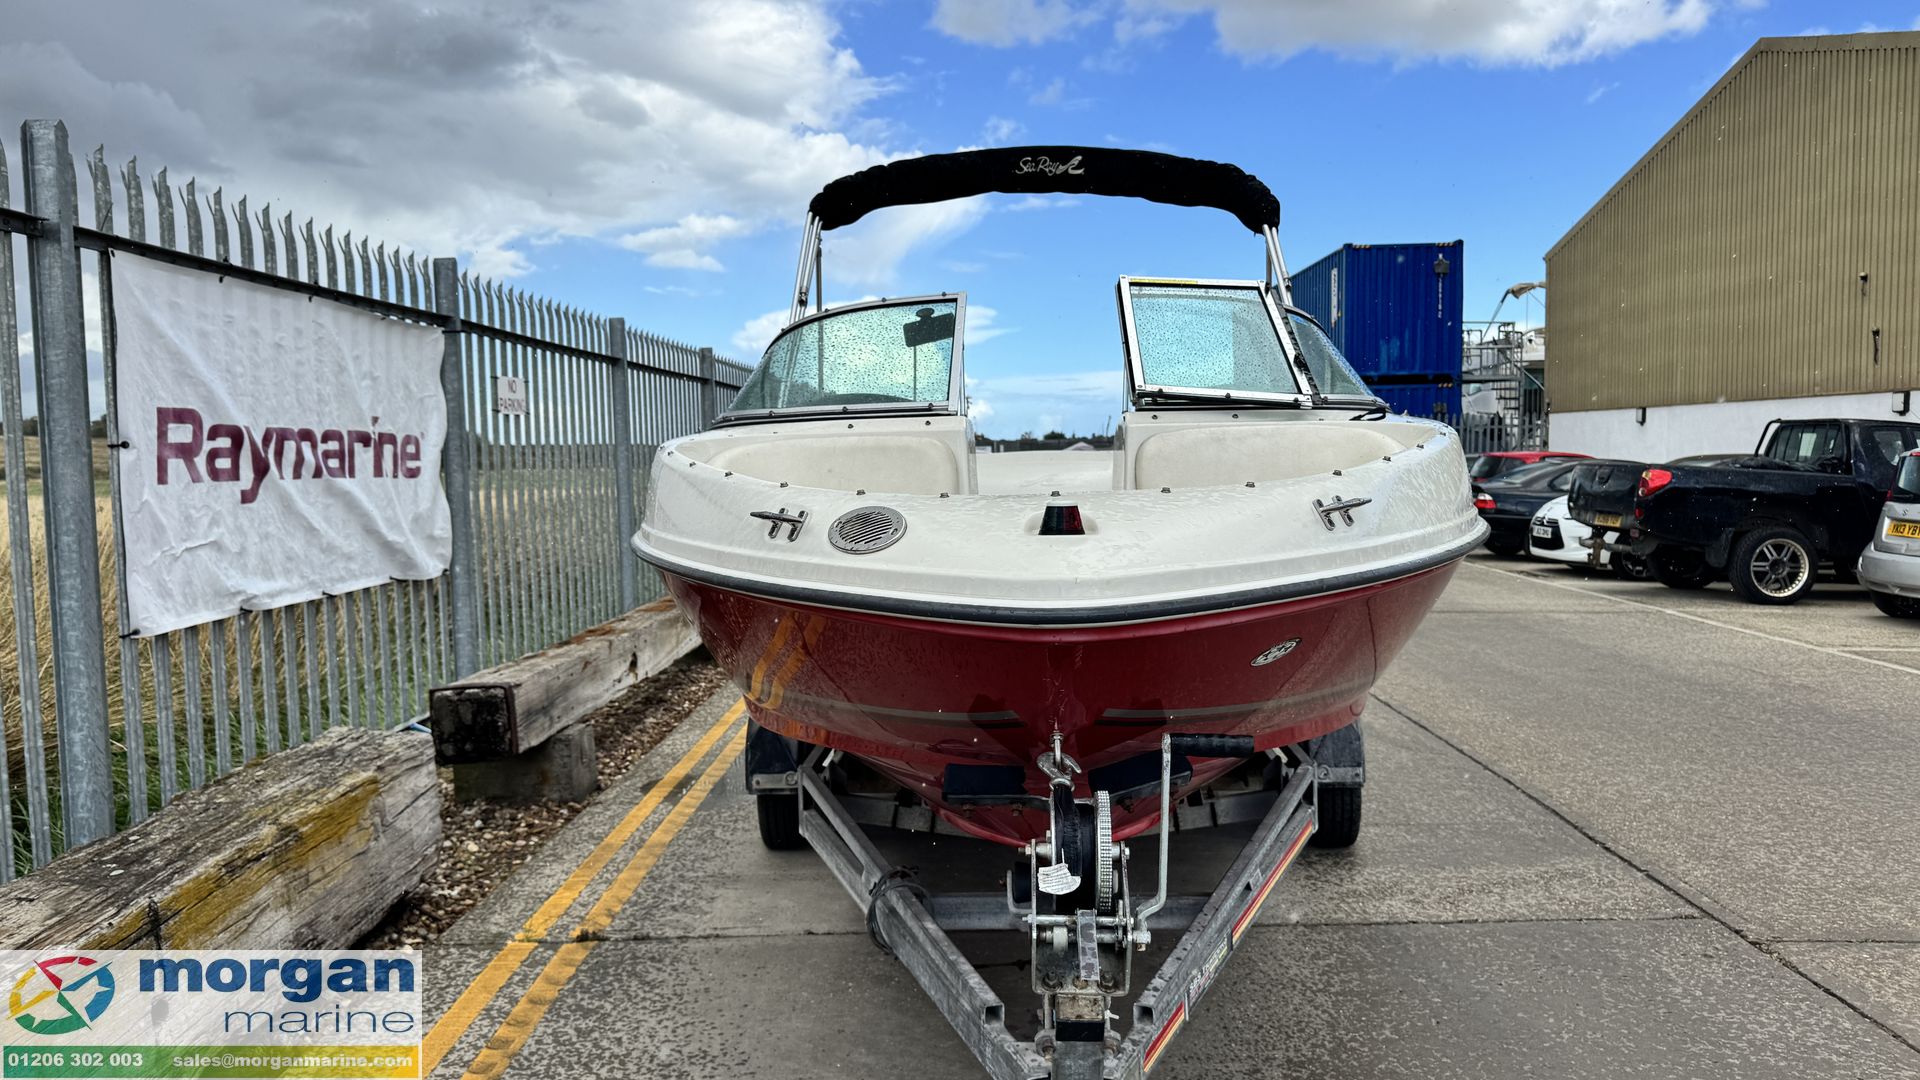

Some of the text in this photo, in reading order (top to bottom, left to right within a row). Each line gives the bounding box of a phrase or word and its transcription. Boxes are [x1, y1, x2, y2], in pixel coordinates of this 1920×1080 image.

[1015, 156, 1059, 176] Sea Ray
[507, 379, 517, 393] NO
[499, 397, 525, 412] PARKING
[156, 406, 423, 504] Raymarine
